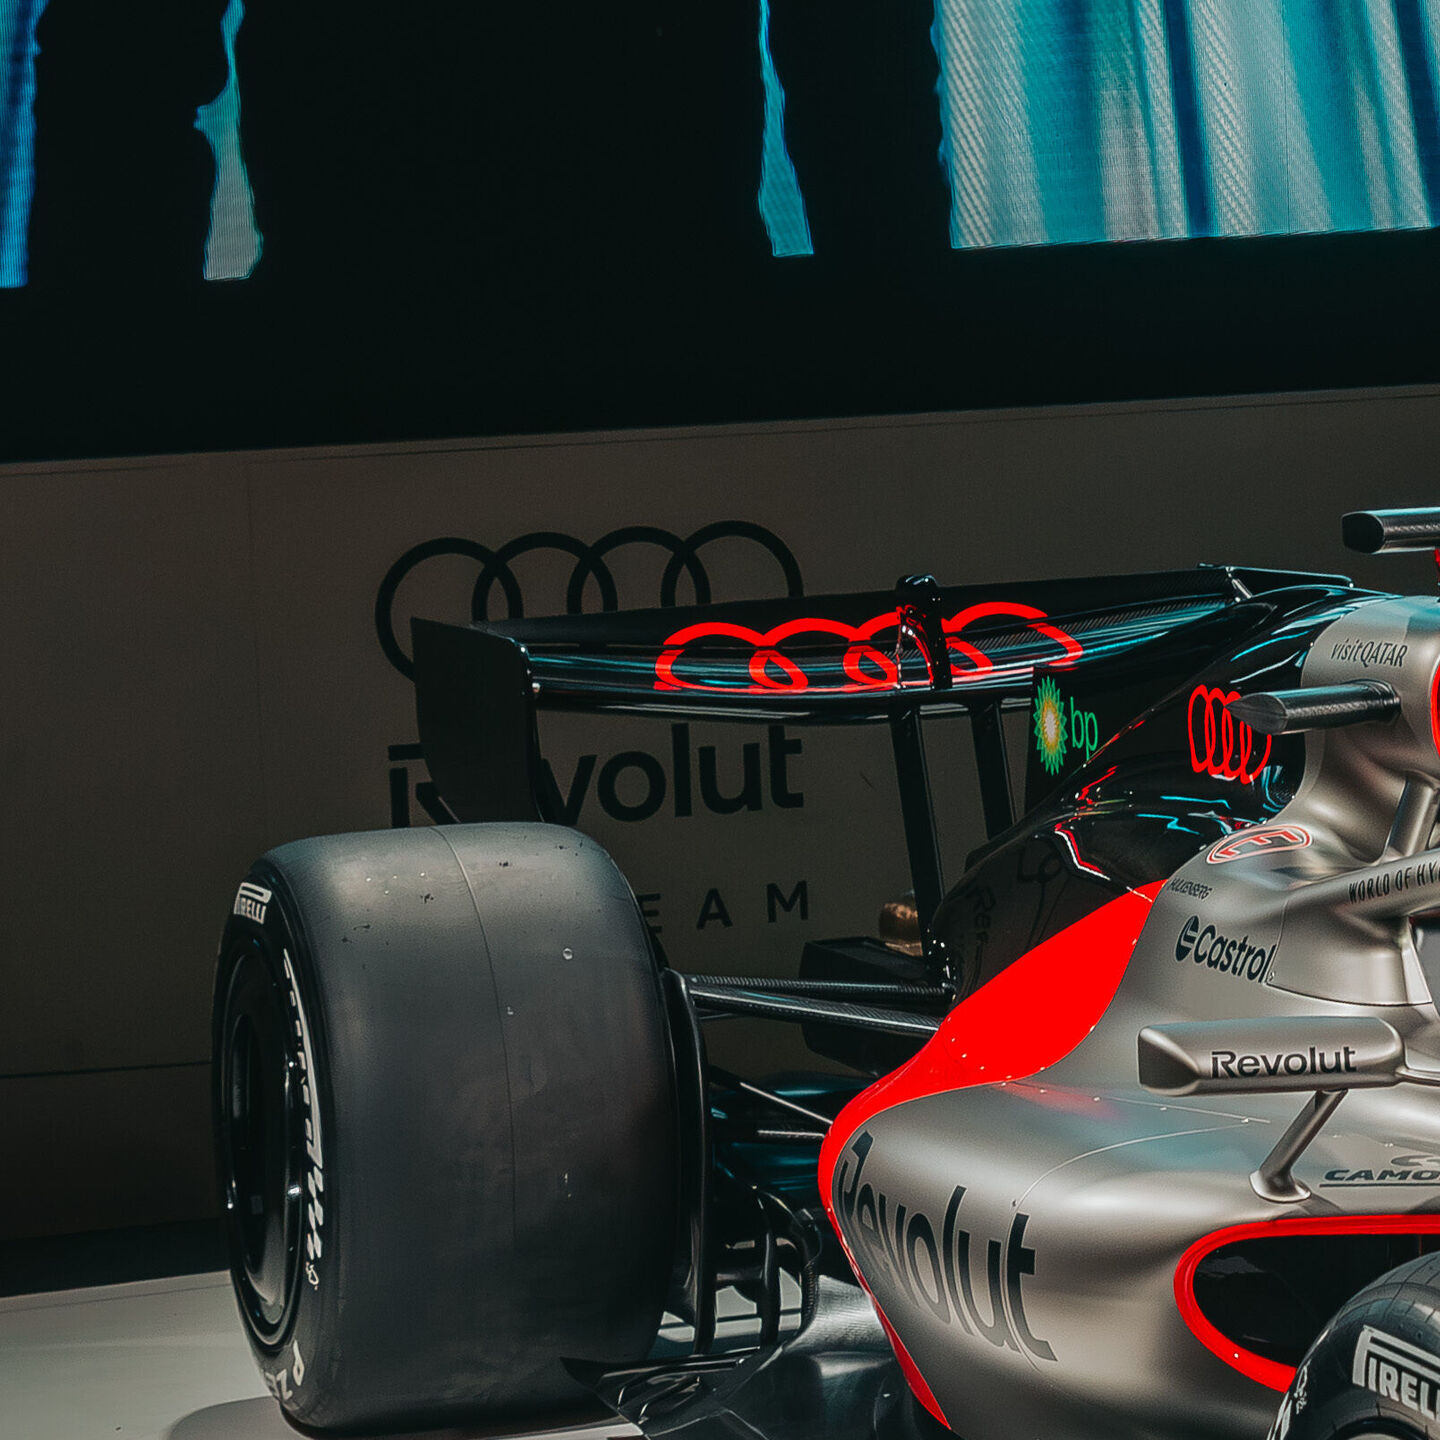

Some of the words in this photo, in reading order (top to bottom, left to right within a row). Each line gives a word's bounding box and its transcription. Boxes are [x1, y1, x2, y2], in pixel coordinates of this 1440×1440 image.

[1070, 696, 1099, 761] bp
[388, 722, 804, 828] Rvolut
[233, 881, 272, 924] PIRELLI
[636, 880, 809, 933] EAM
[1348, 873, 1390, 904] WORLD
[1395, 867, 1413, 891] OF
[1193, 924, 1278, 983] Castrol
[1210, 1045, 1357, 1079] Revolut
